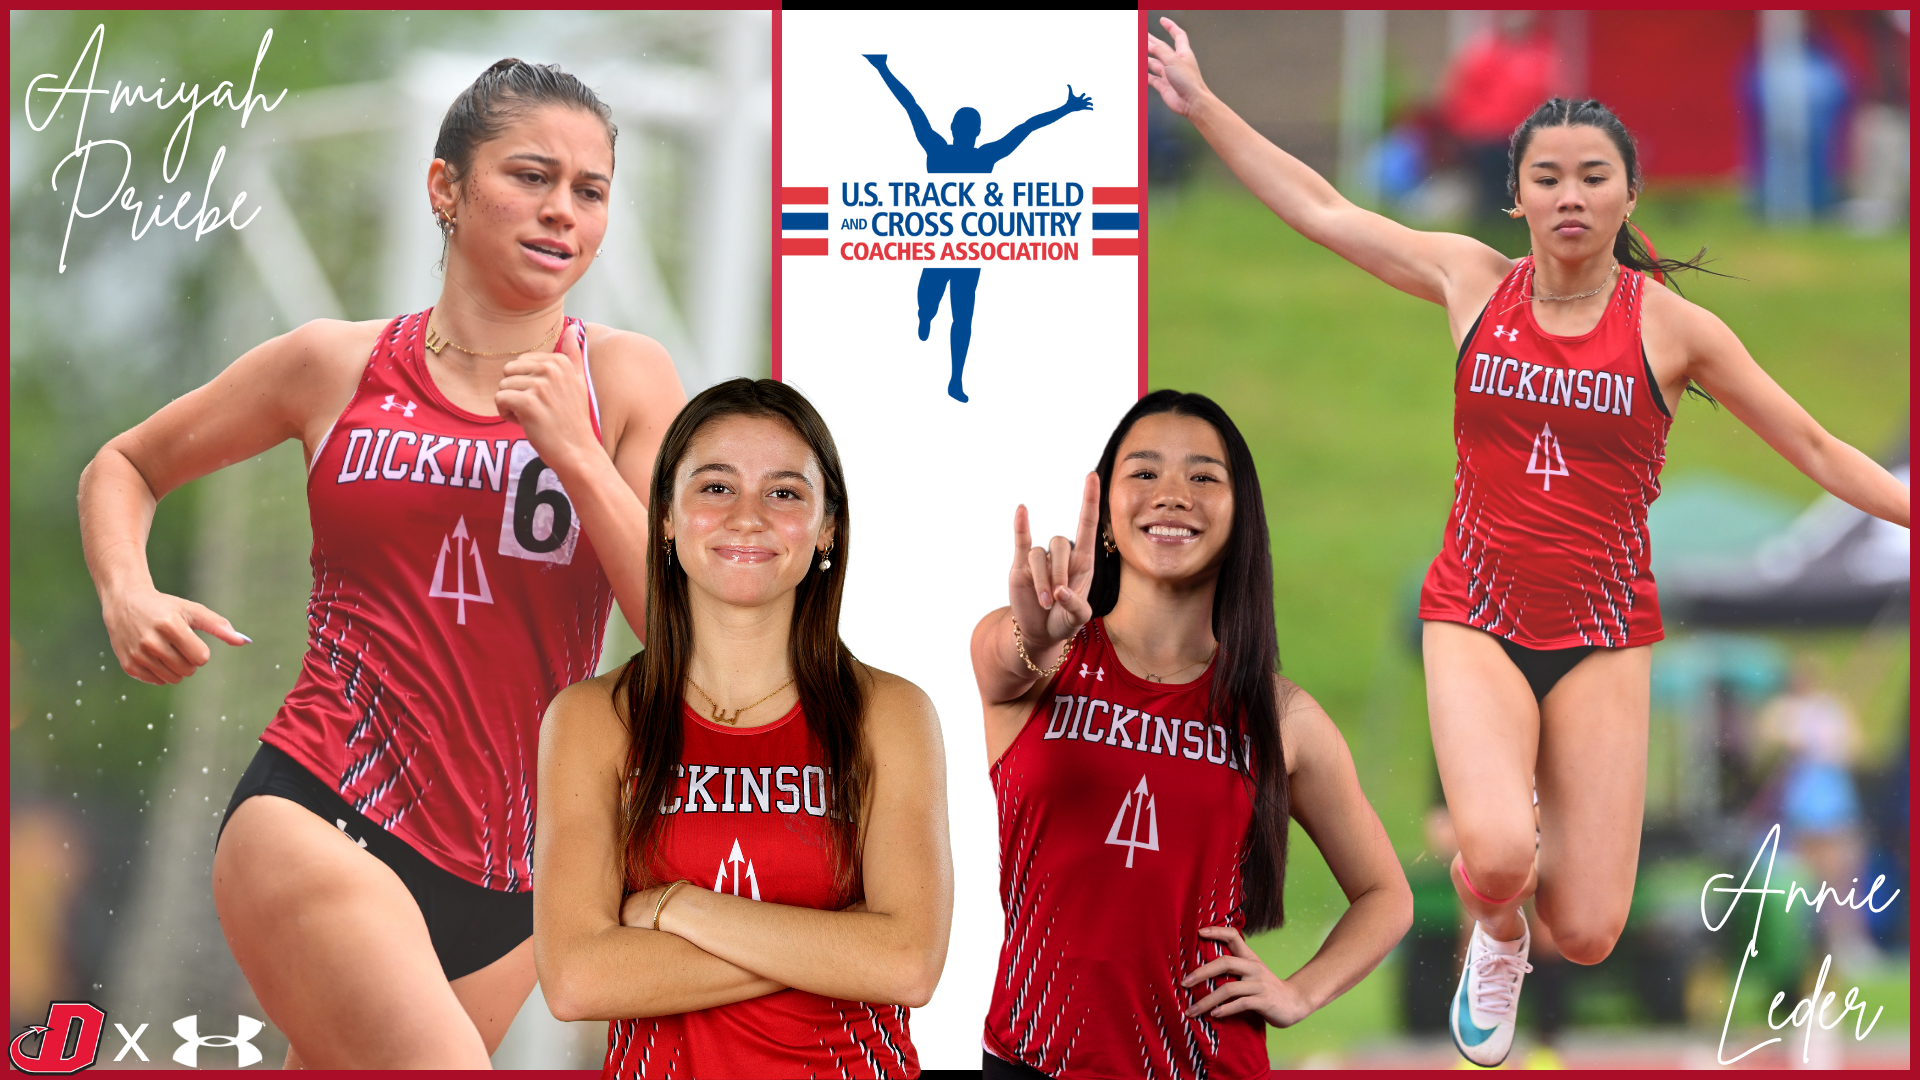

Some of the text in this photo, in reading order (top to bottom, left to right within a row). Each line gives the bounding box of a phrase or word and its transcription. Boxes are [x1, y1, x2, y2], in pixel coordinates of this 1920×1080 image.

[1469, 352, 1635, 417] DICKINSON
[337, 427, 532, 493] DICKIN
[512, 456, 572, 554] 6
